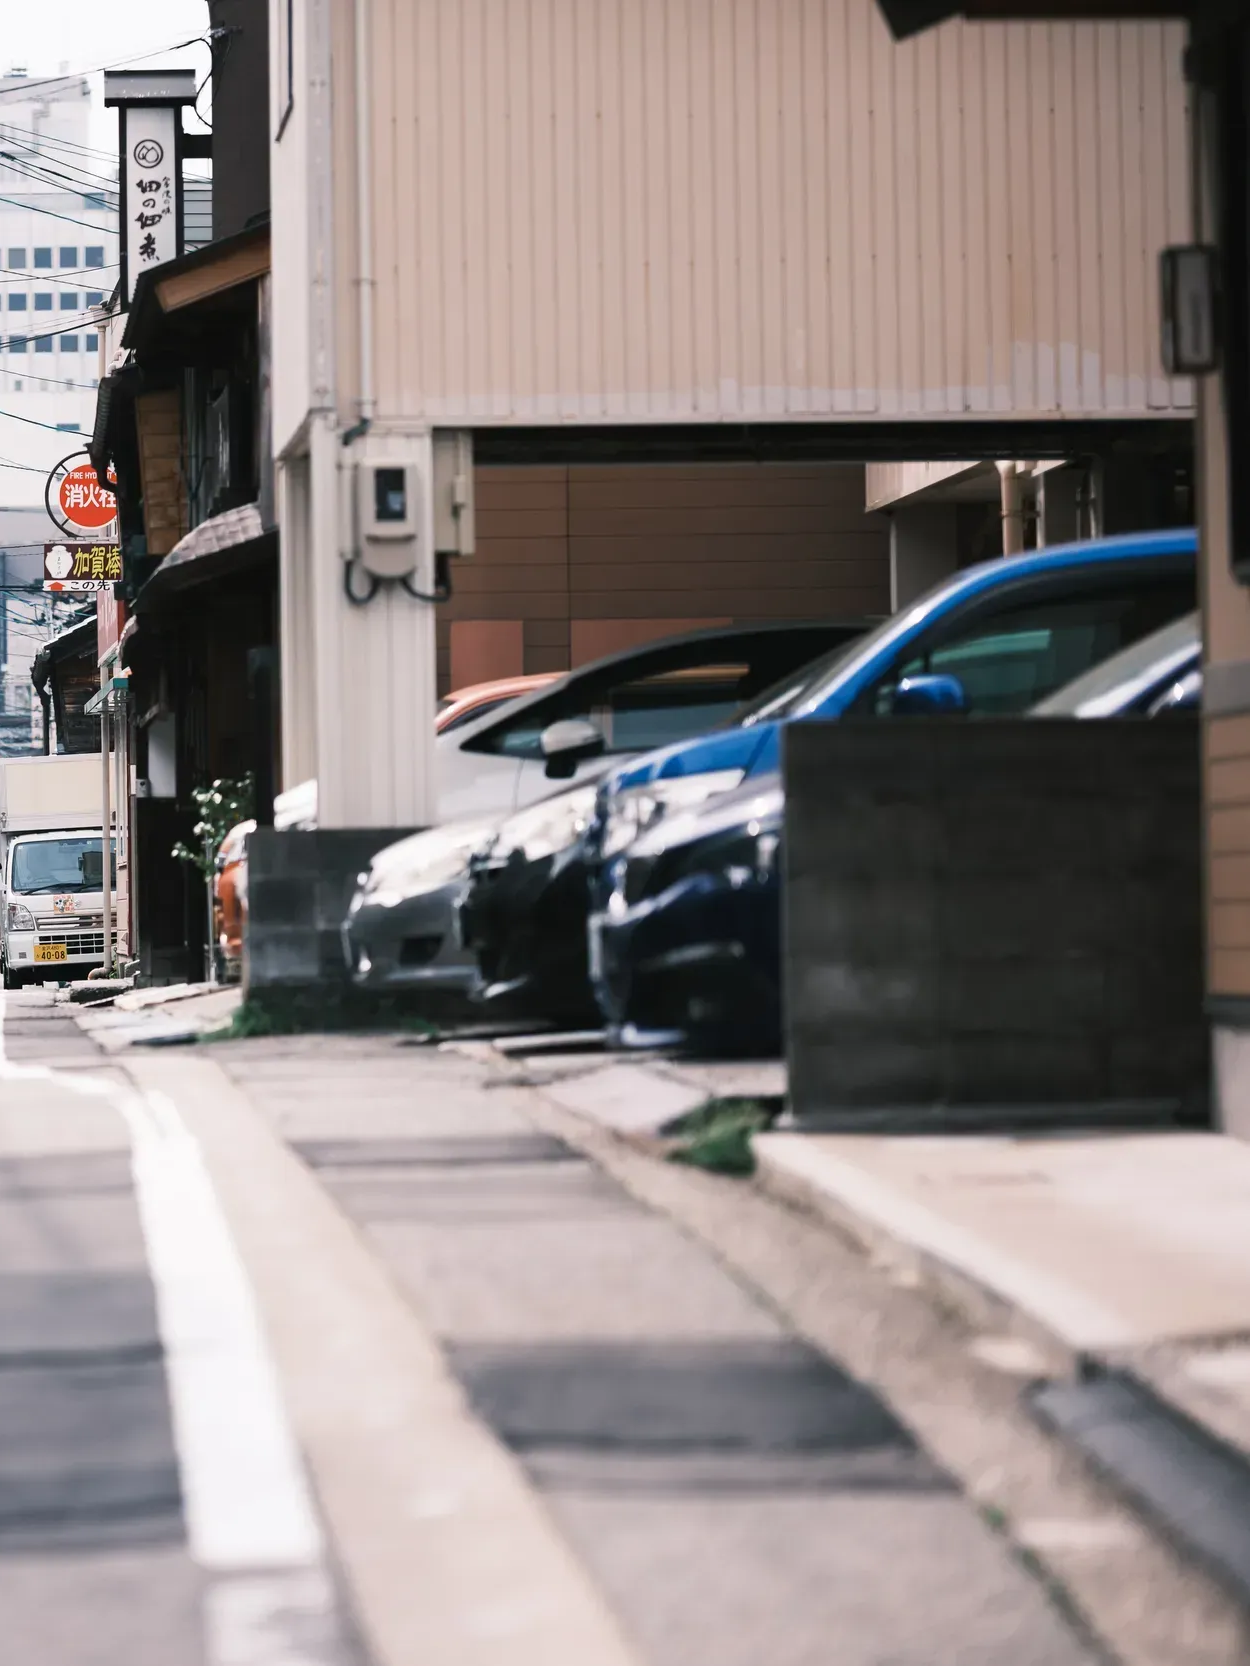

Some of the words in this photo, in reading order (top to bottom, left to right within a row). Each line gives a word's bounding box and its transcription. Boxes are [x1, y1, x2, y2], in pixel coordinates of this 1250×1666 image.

[135, 179, 162, 262] 佃の佃煮
[73, 545, 120, 579] 加賀棒
